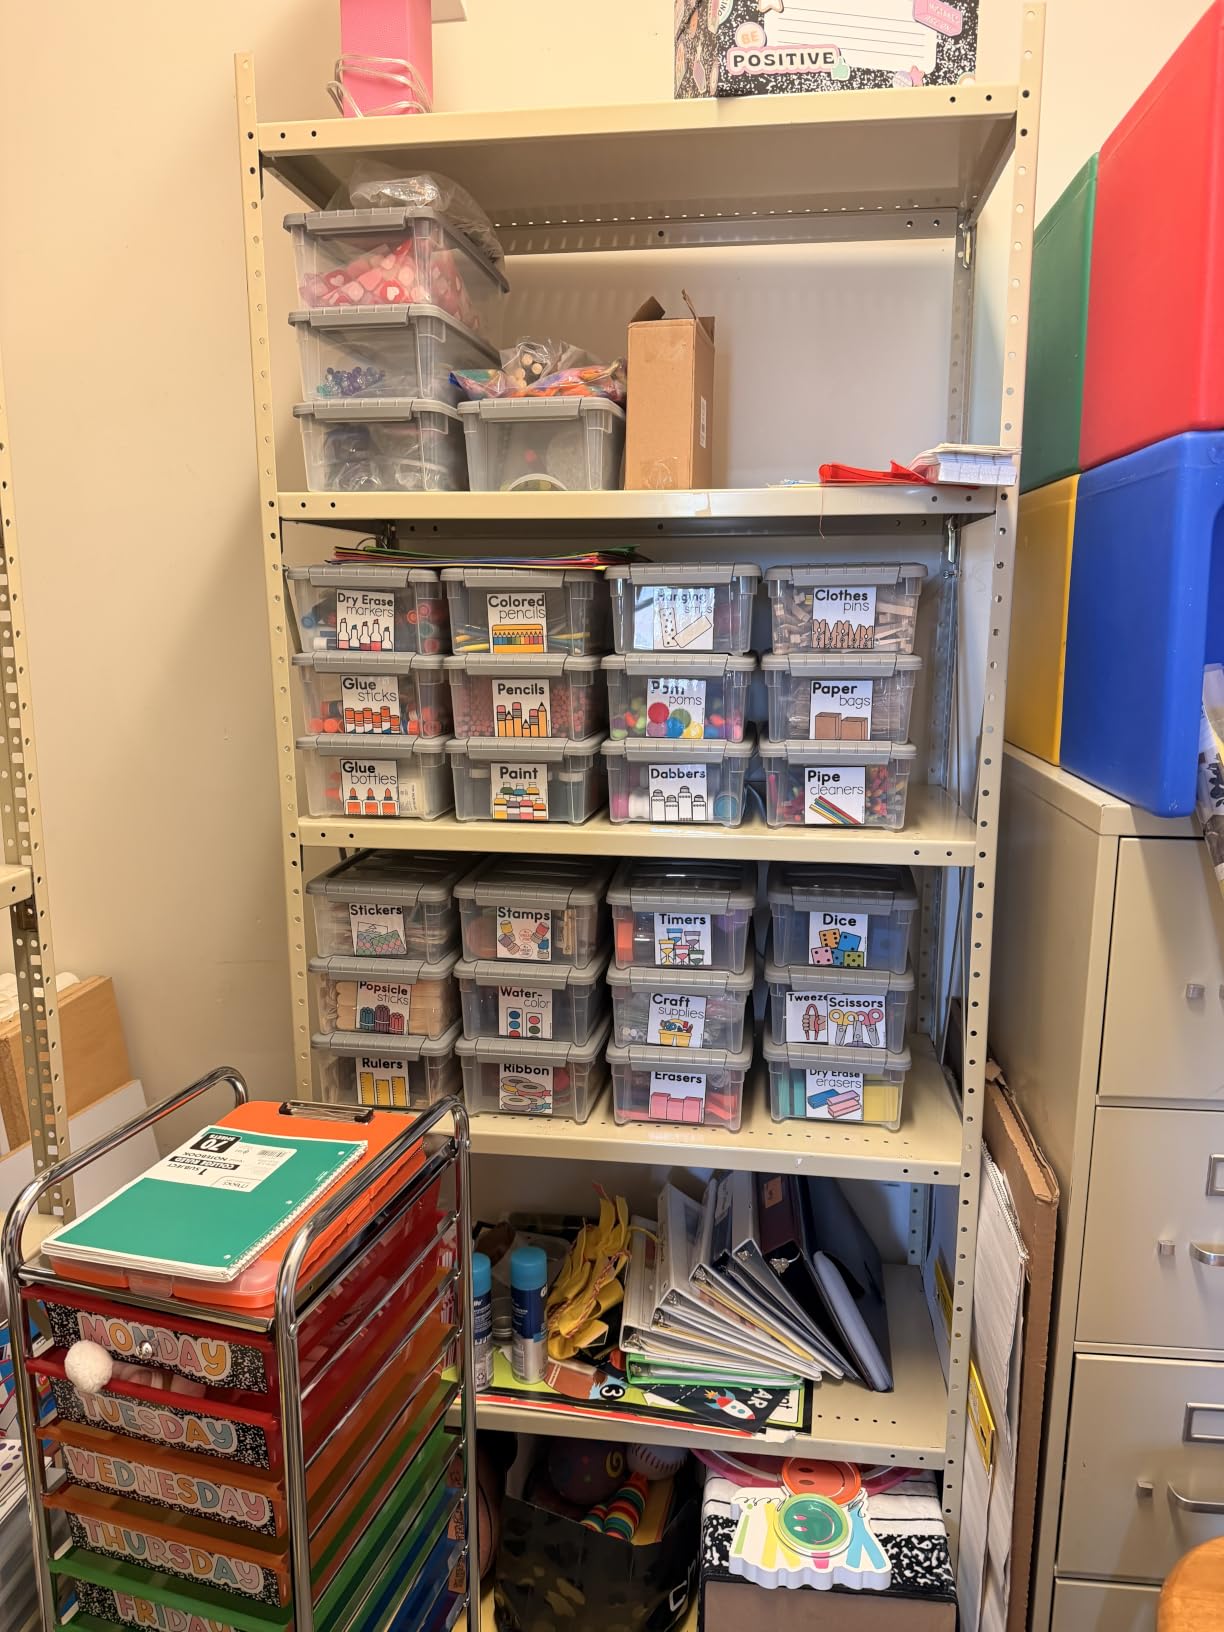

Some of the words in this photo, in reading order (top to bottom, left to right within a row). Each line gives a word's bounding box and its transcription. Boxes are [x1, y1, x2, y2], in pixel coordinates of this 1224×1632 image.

[741, 31, 759, 44] BE
[733, 52, 835, 67] POSITIVE
[337, 592, 358, 607] Dry
[362, 593, 394, 608] Erase
[488, 595, 545, 608] Colored
[815, 589, 868, 602] Clothes
[346, 604, 394, 618] markers
[843, 600, 870, 613] pins
[499, 605, 546, 623] pencils
[342, 677, 376, 690] Glue
[497, 683, 545, 696] Pencils
[812, 682, 857, 697] Paper
[358, 689, 397, 702] sticks
[669, 696, 702, 708] poms
[839, 693, 871, 709] bags
[342, 760, 376, 774] Glue
[500, 766, 538, 780] Paint
[350, 772, 397, 785] bottles
[651, 768, 705, 780] Dabbers
[807, 769, 841, 784] Pipe
[810, 783, 864, 796] cleaners
[350, 904, 403, 917] Stickers
[498, 906, 550, 921] Stamps
[659, 914, 706, 925] Timers
[823, 913, 857, 927] Dice
[360, 980, 408, 996] Popsicle
[500, 985, 543, 999] Water-
[377, 993, 409, 1006] sticks
[523, 997, 551, 1009] color
[652, 993, 690, 1008] Craft
[829, 997, 884, 1008] Scissors
[658, 1006, 705, 1020] supplies
[362, 1057, 403, 1069] Rulers
[503, 1063, 550, 1076] Ribbon
[655, 1072, 703, 1084] Erasers
[809, 1069, 828, 1079] Dry
[831, 1070, 860, 1078] Erase
[815, 1078, 862, 1089] erasers
[200, 1139, 228, 1151] 70
[183, 1152, 228, 1161] NOTEBOOK
[167, 1163, 201, 1171] SUBJECT
[81, 1315, 227, 1377] MONDAY
[81, 1391, 233, 1450] TUESDAY
[67, 1449, 266, 1521] WEDNESDAY
[81, 1516, 261, 1590] THURSDAY
